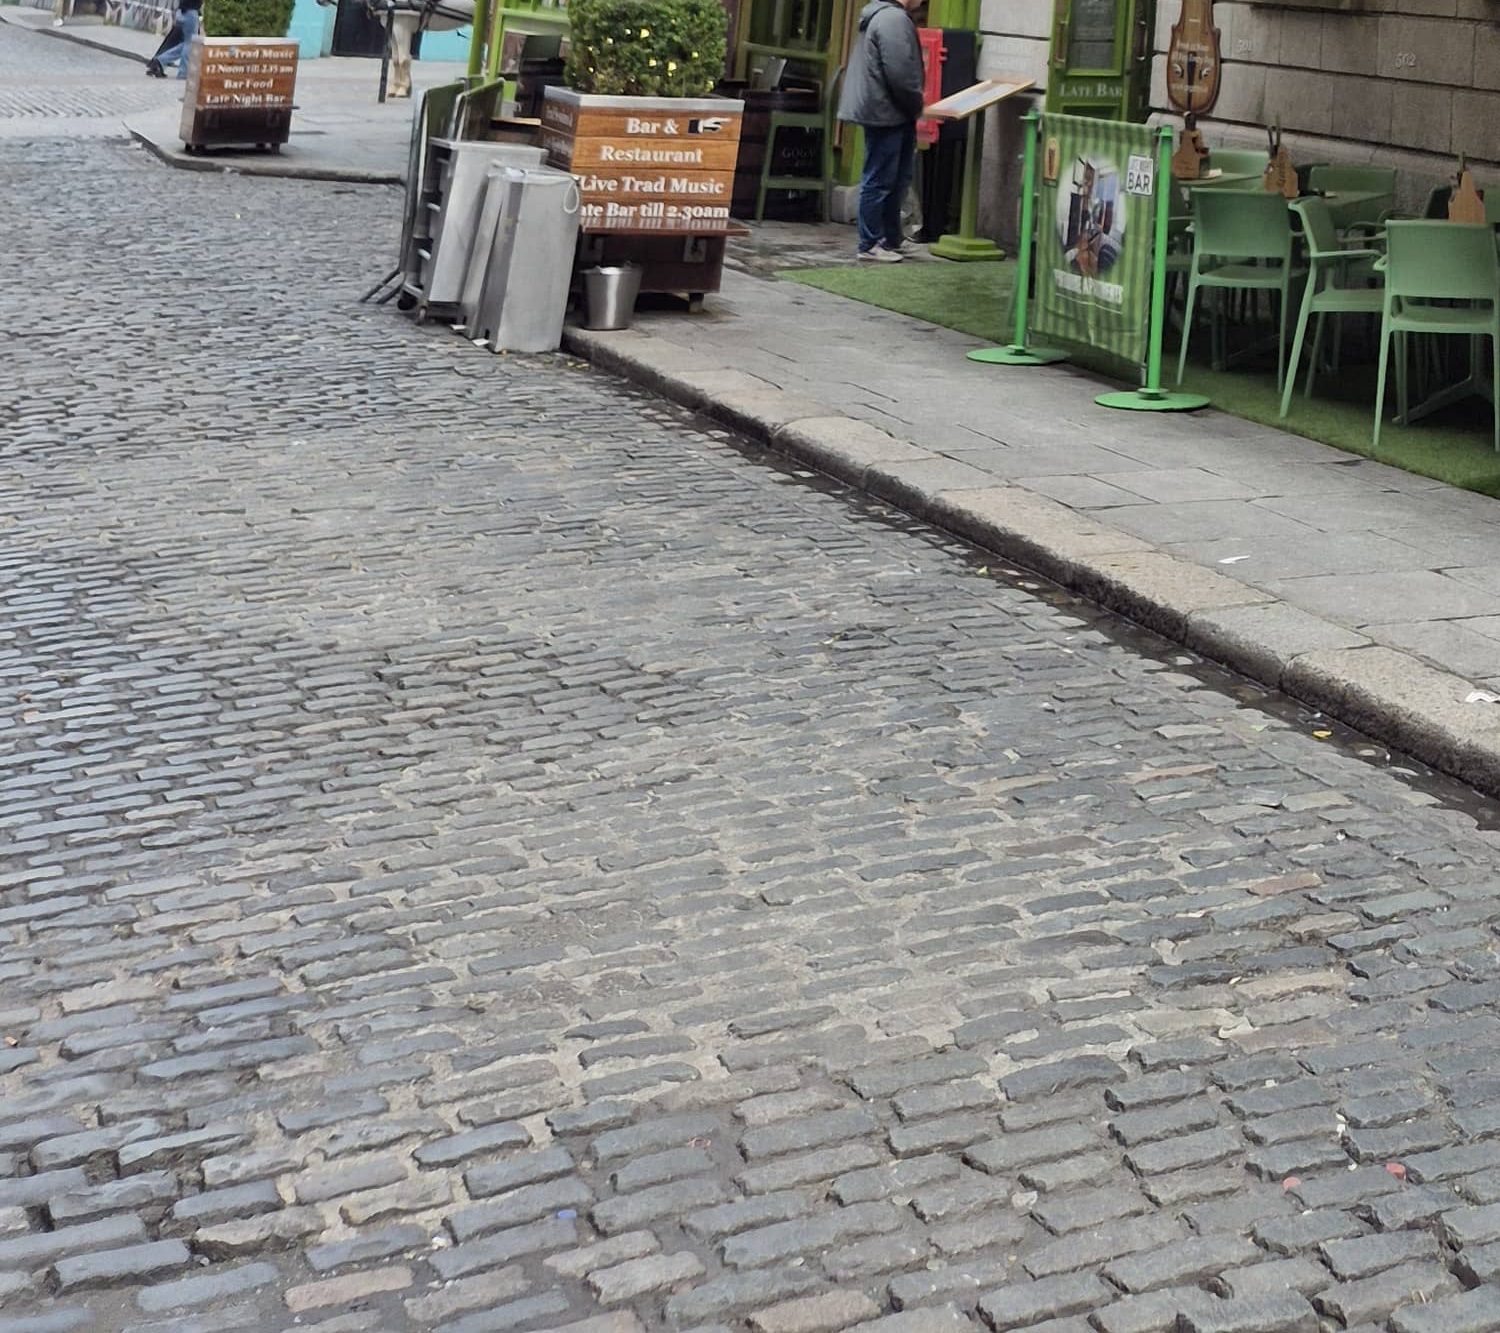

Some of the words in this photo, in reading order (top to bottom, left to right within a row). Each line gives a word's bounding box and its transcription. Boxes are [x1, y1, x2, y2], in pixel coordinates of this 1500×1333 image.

[224, 79, 246, 89] Bar
[232, 93, 262, 106] Night
[626, 117, 661, 134] Bar
[663, 118, 680, 135] &
[600, 145, 704, 164] Restaurant
[579, 174, 618, 192] Live
[621, 175, 665, 194] Trad
[669, 177, 725, 194] Music
[1128, 172, 1151, 193] BAR
[580, 204, 604, 218] ate
[606, 202, 637, 218] Bar
[640, 202, 664, 218] till
[666, 206, 729, 221] 2.30am
